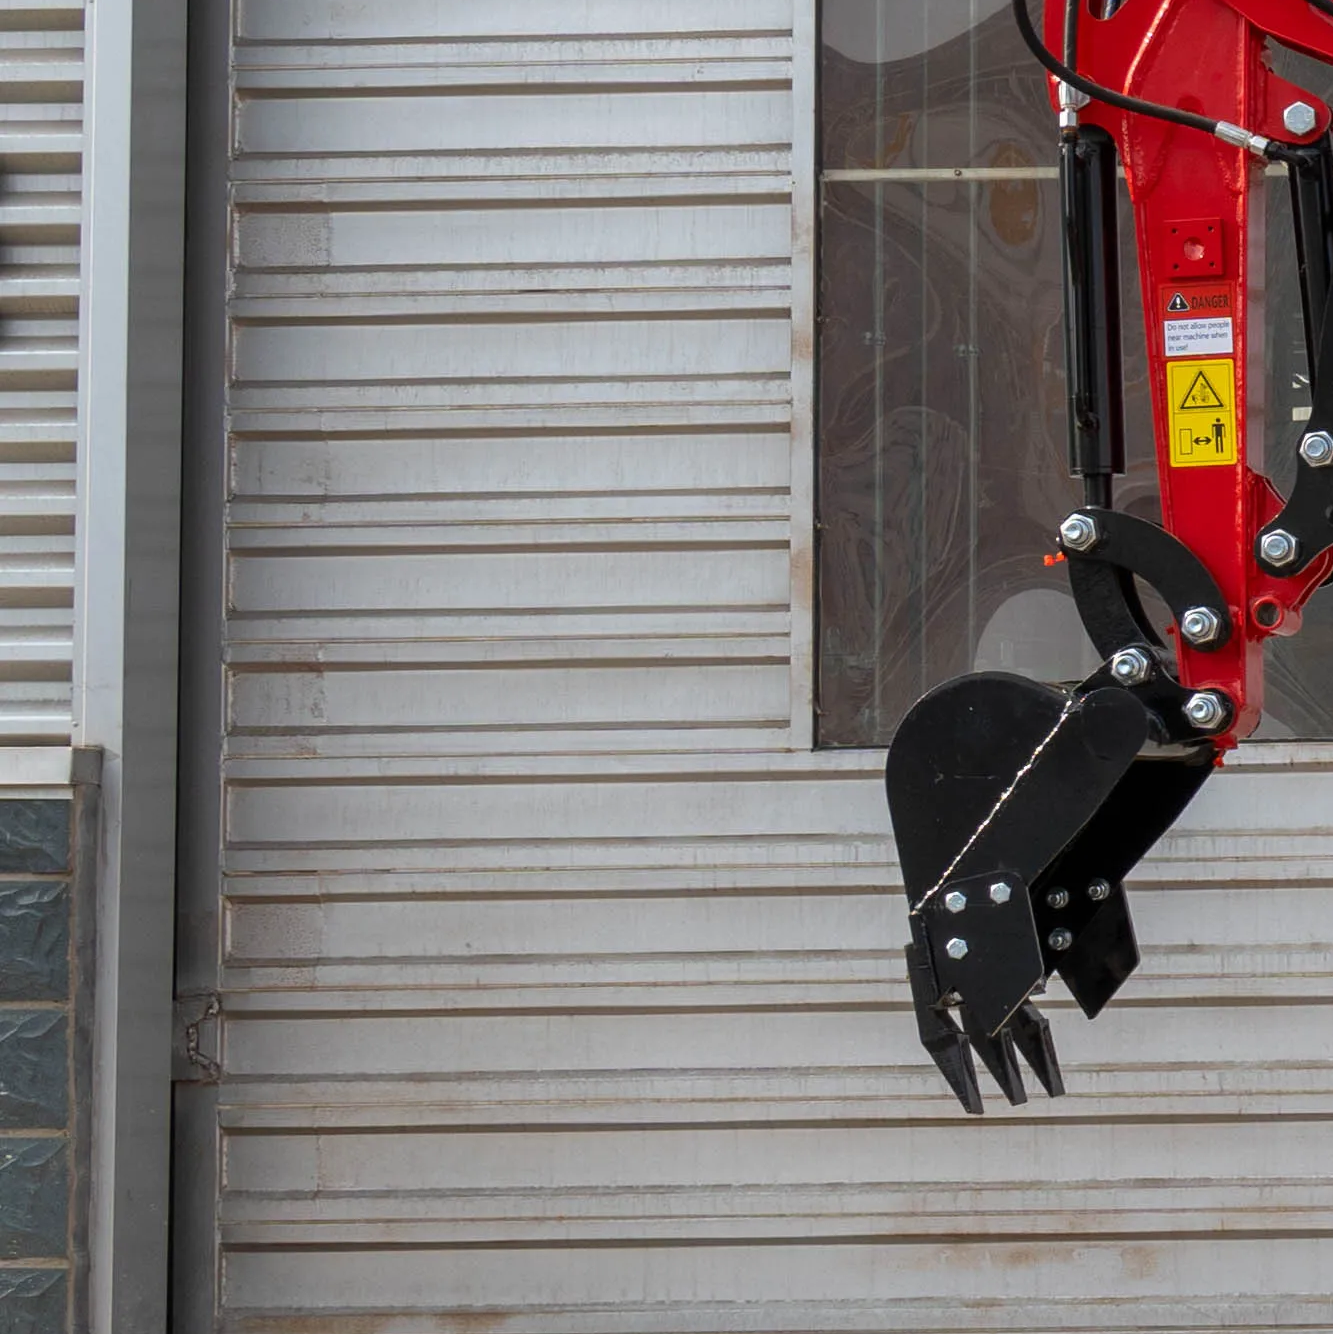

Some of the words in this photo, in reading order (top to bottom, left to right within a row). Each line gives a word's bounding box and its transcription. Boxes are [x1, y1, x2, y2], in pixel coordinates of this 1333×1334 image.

[1191, 295, 1228, 309] DANGER
[1167, 323, 1177, 331] Do
[1178, 323, 1189, 331] not
[1190, 322, 1207, 330] allow
[1207, 321, 1230, 330] people
[1182, 333, 1210, 341] machine
[1211, 331, 1228, 339] when
